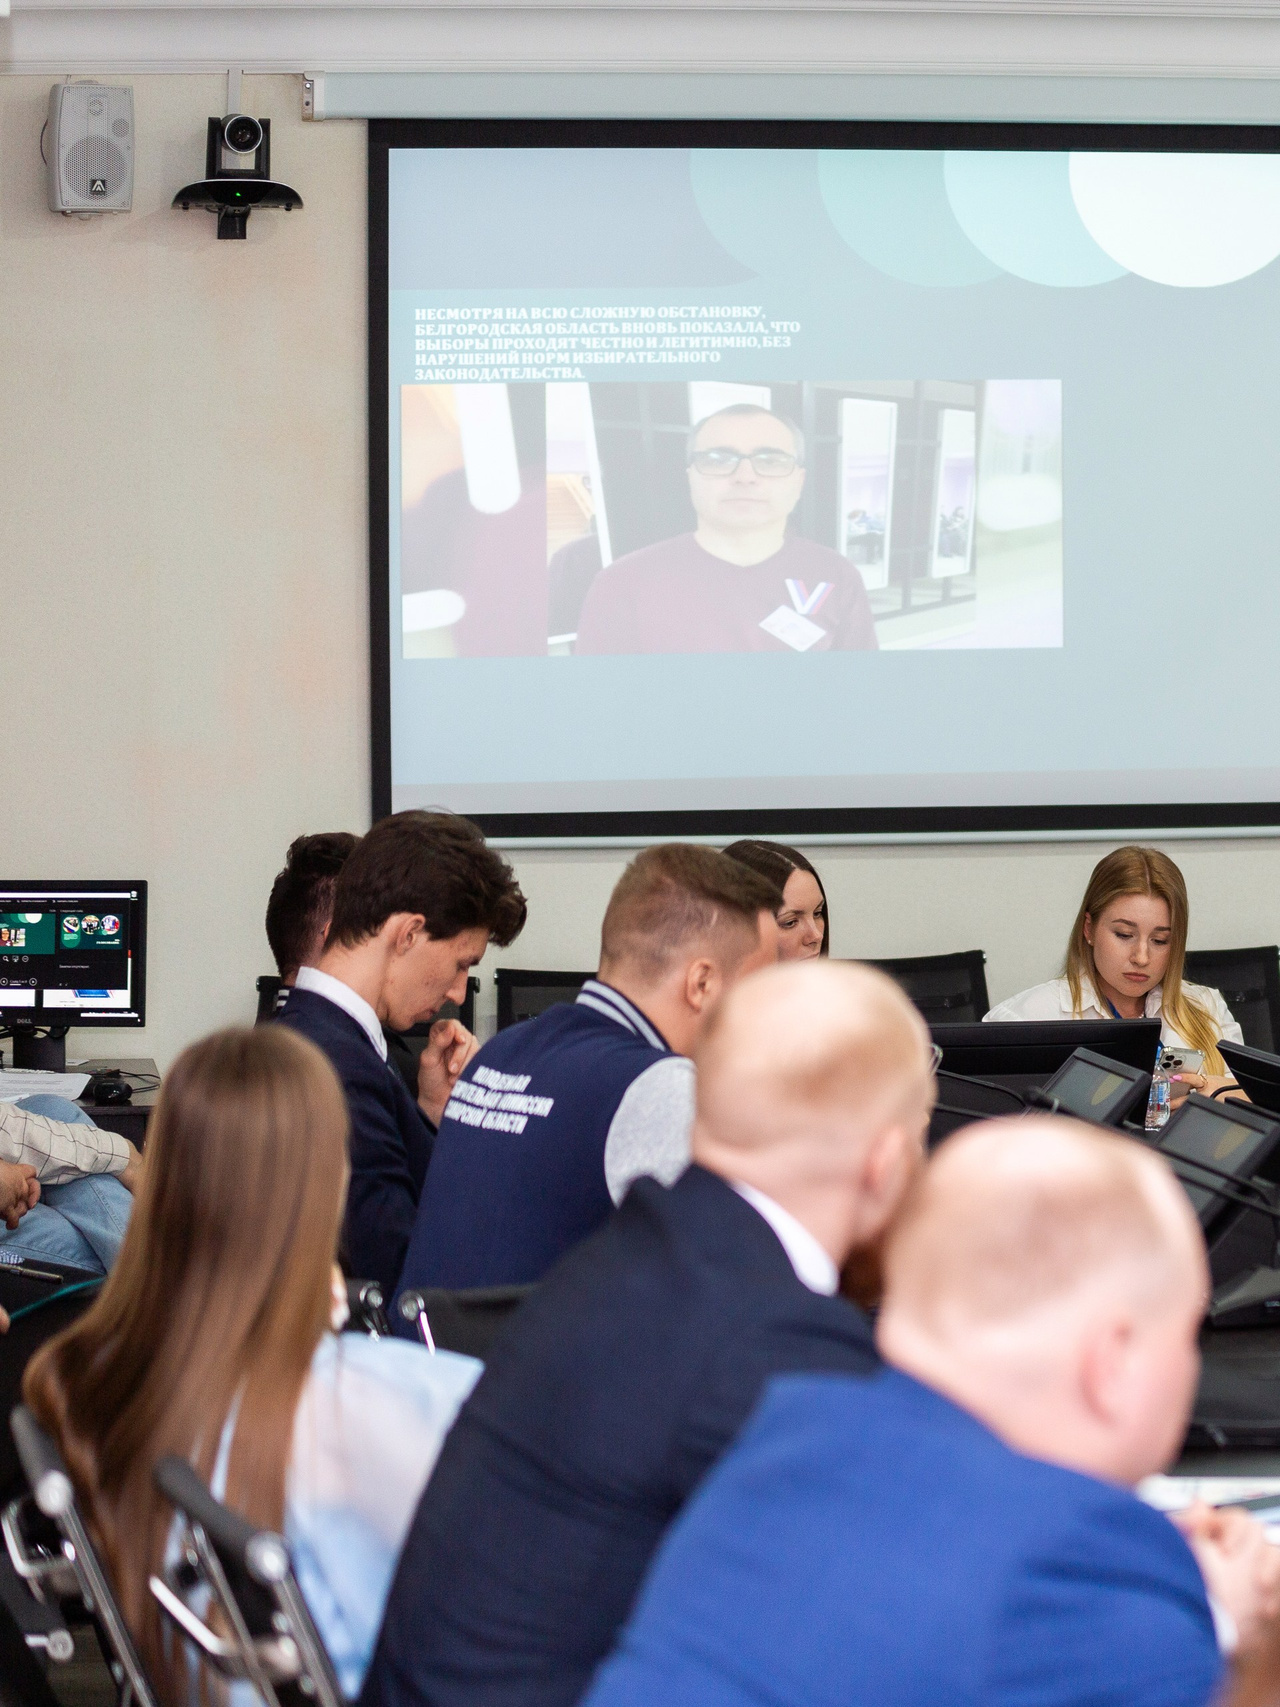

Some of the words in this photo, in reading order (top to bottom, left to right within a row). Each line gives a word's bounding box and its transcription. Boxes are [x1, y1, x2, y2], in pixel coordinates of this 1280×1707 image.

[415, 308, 503, 320] НЕСМОТРЯ
[506, 308, 528, 320] НА
[531, 308, 567, 319] ВСЮ
[570, 306, 655, 319] СЛОЖНУЮ
[658, 305, 765, 320] ОБСТАНОВКУ,
[415, 323, 542, 337] БЕЛГОРОДСКАЯ
[545, 322, 619, 335] ОБЛАСТЬ
[622, 322, 678, 334] ВНОВЬ
[680, 321, 768, 335] ПОКАЗАЛА,
[770, 321, 800, 333] ЧТО
[415, 338, 490, 351] ВЫБОРЫ
[492, 337, 578, 352] ПРОХОДЯТ
[581, 336, 644, 349] ЧЕСТНО
[646, 336, 657, 349] И
[659, 336, 761, 349] ЛЕГИТИМНО,
[763, 335, 791, 348] БЕЗ
[415, 350, 520, 366] НАРУШЕНИЙ
[522, 352, 570, 365] НОРМ
[572, 350, 720, 364] ИЗБИРАТЕЛЬНОГО
[415, 366, 586, 382] ЗАКОНОДАТЕЛЬСТВА.
